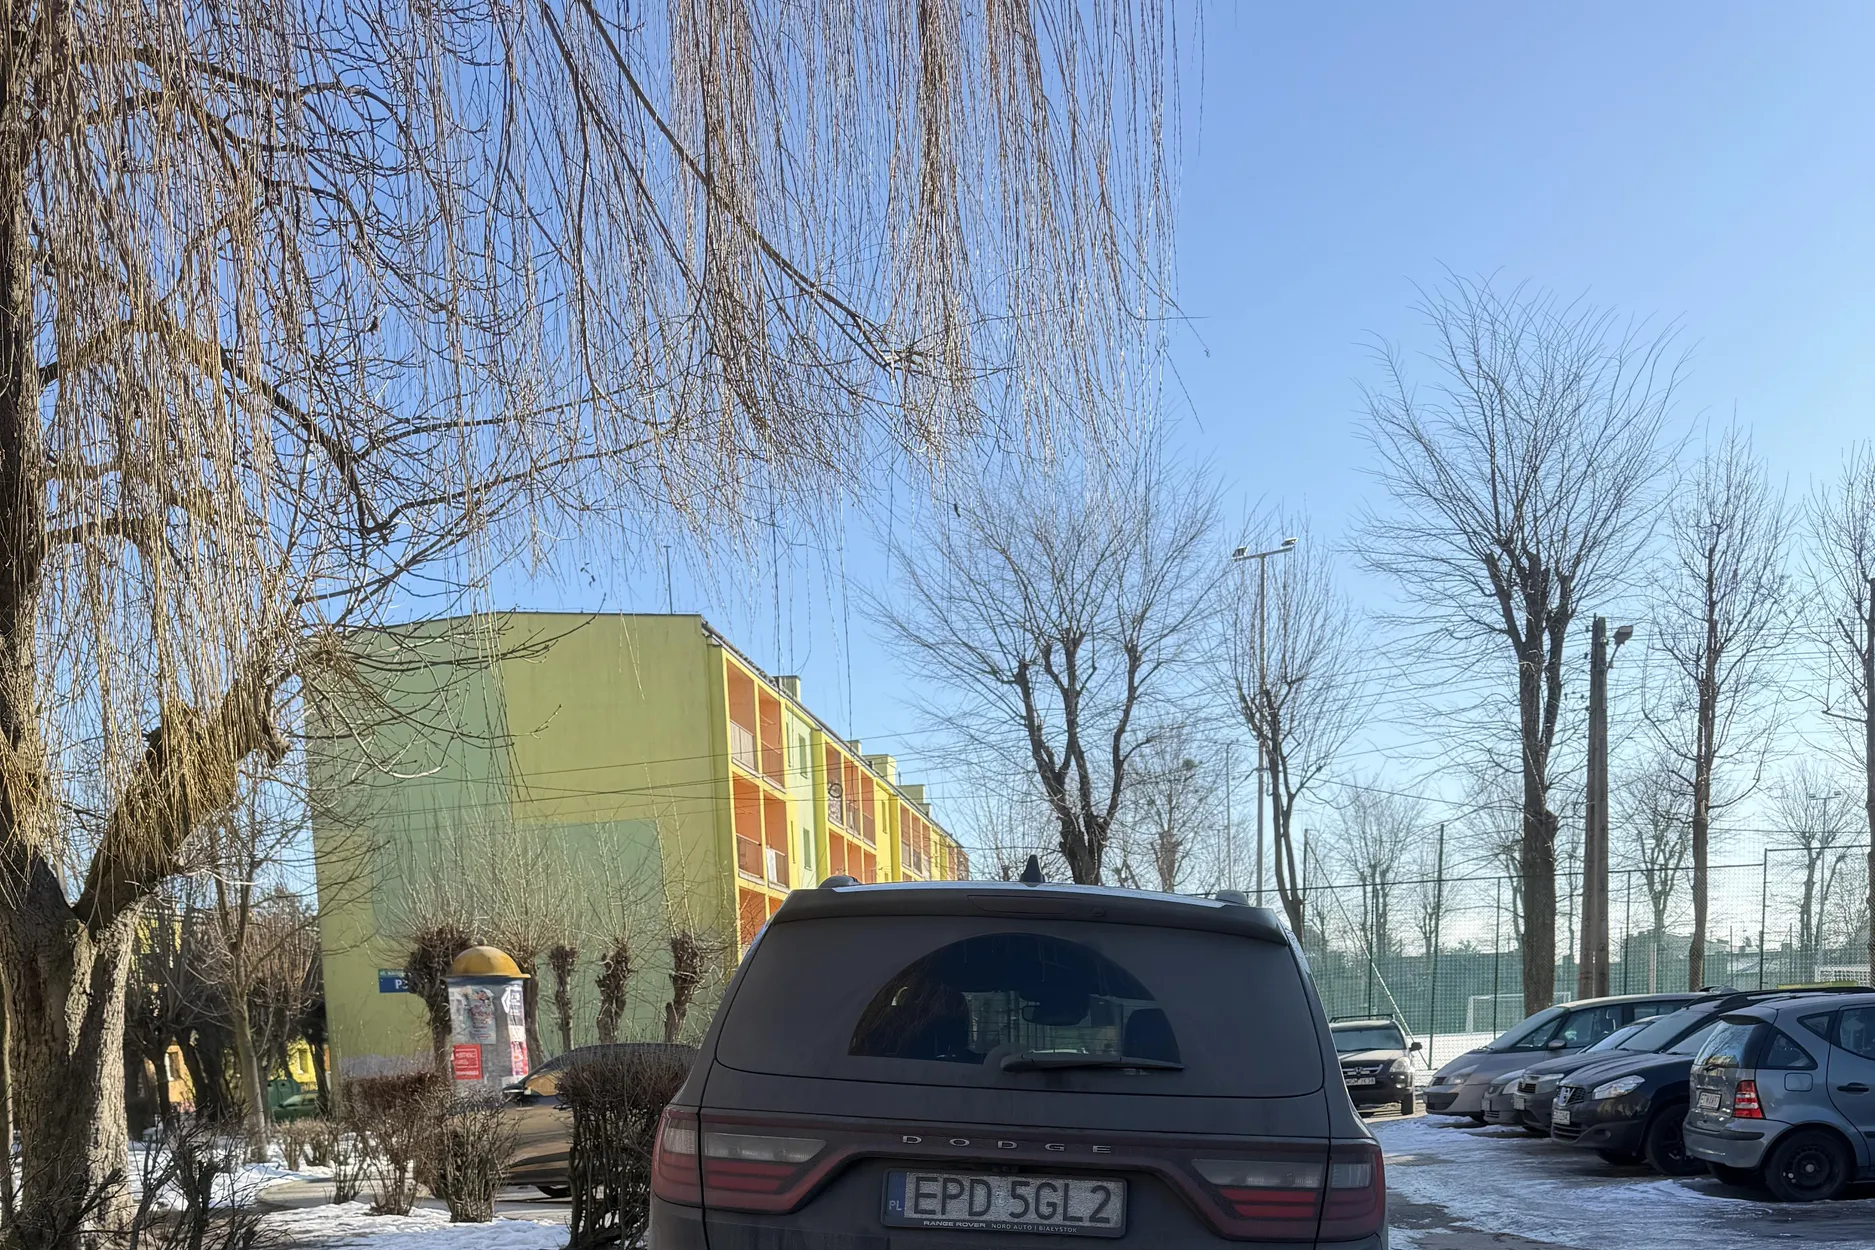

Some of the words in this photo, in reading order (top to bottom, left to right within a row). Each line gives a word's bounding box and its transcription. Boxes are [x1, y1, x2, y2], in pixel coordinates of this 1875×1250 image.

[902, 1135, 1112, 1154] DODGE
[888, 1200, 903, 1211] PL
[913, 1176, 992, 1217] EPD
[1008, 1180, 1113, 1224] 5GL2
[923, 1220, 954, 1228] RANGE
[955, 1221, 986, 1229] ROVER
